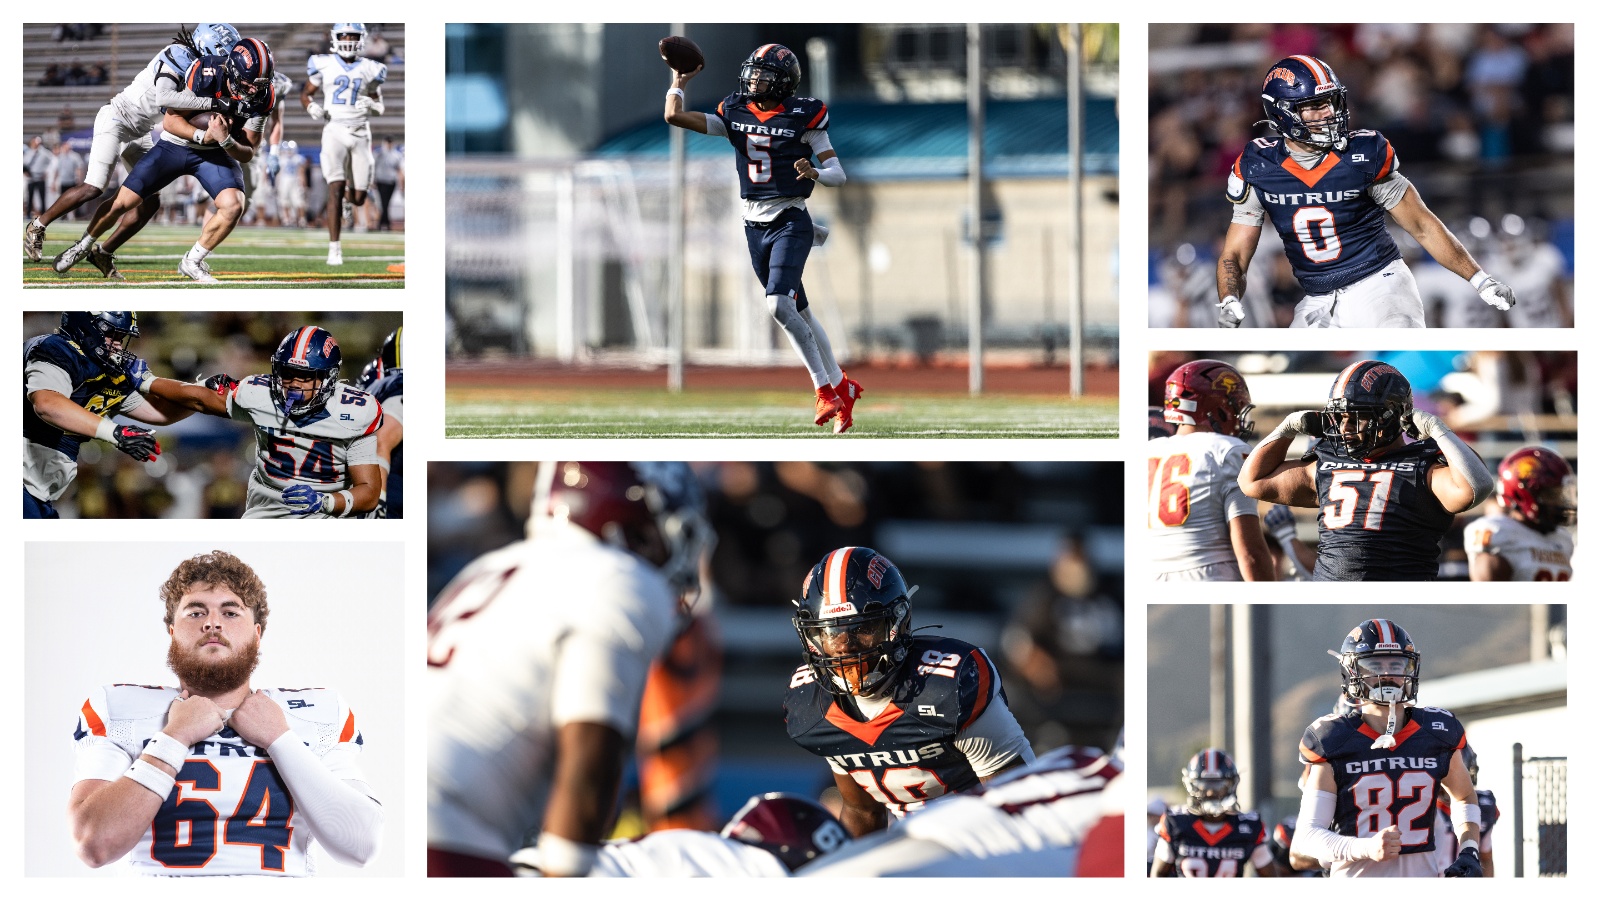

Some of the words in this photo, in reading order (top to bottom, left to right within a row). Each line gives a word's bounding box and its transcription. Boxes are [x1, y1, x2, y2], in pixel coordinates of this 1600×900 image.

[332, 75, 362, 105] 21
[731, 121, 796, 138] CITRUS
[746, 133, 772, 184] 5
[1264, 189, 1361, 205] CITRUS
[1292, 205, 1343, 264] 0
[263, 437, 340, 484] 54
[1323, 469, 1395, 531] 51
[1346, 757, 1438, 774] CITRUS
[150, 759, 294, 872] 64
[1353, 770, 1436, 847] 82
[1178, 845, 1245, 860] CITRUS
